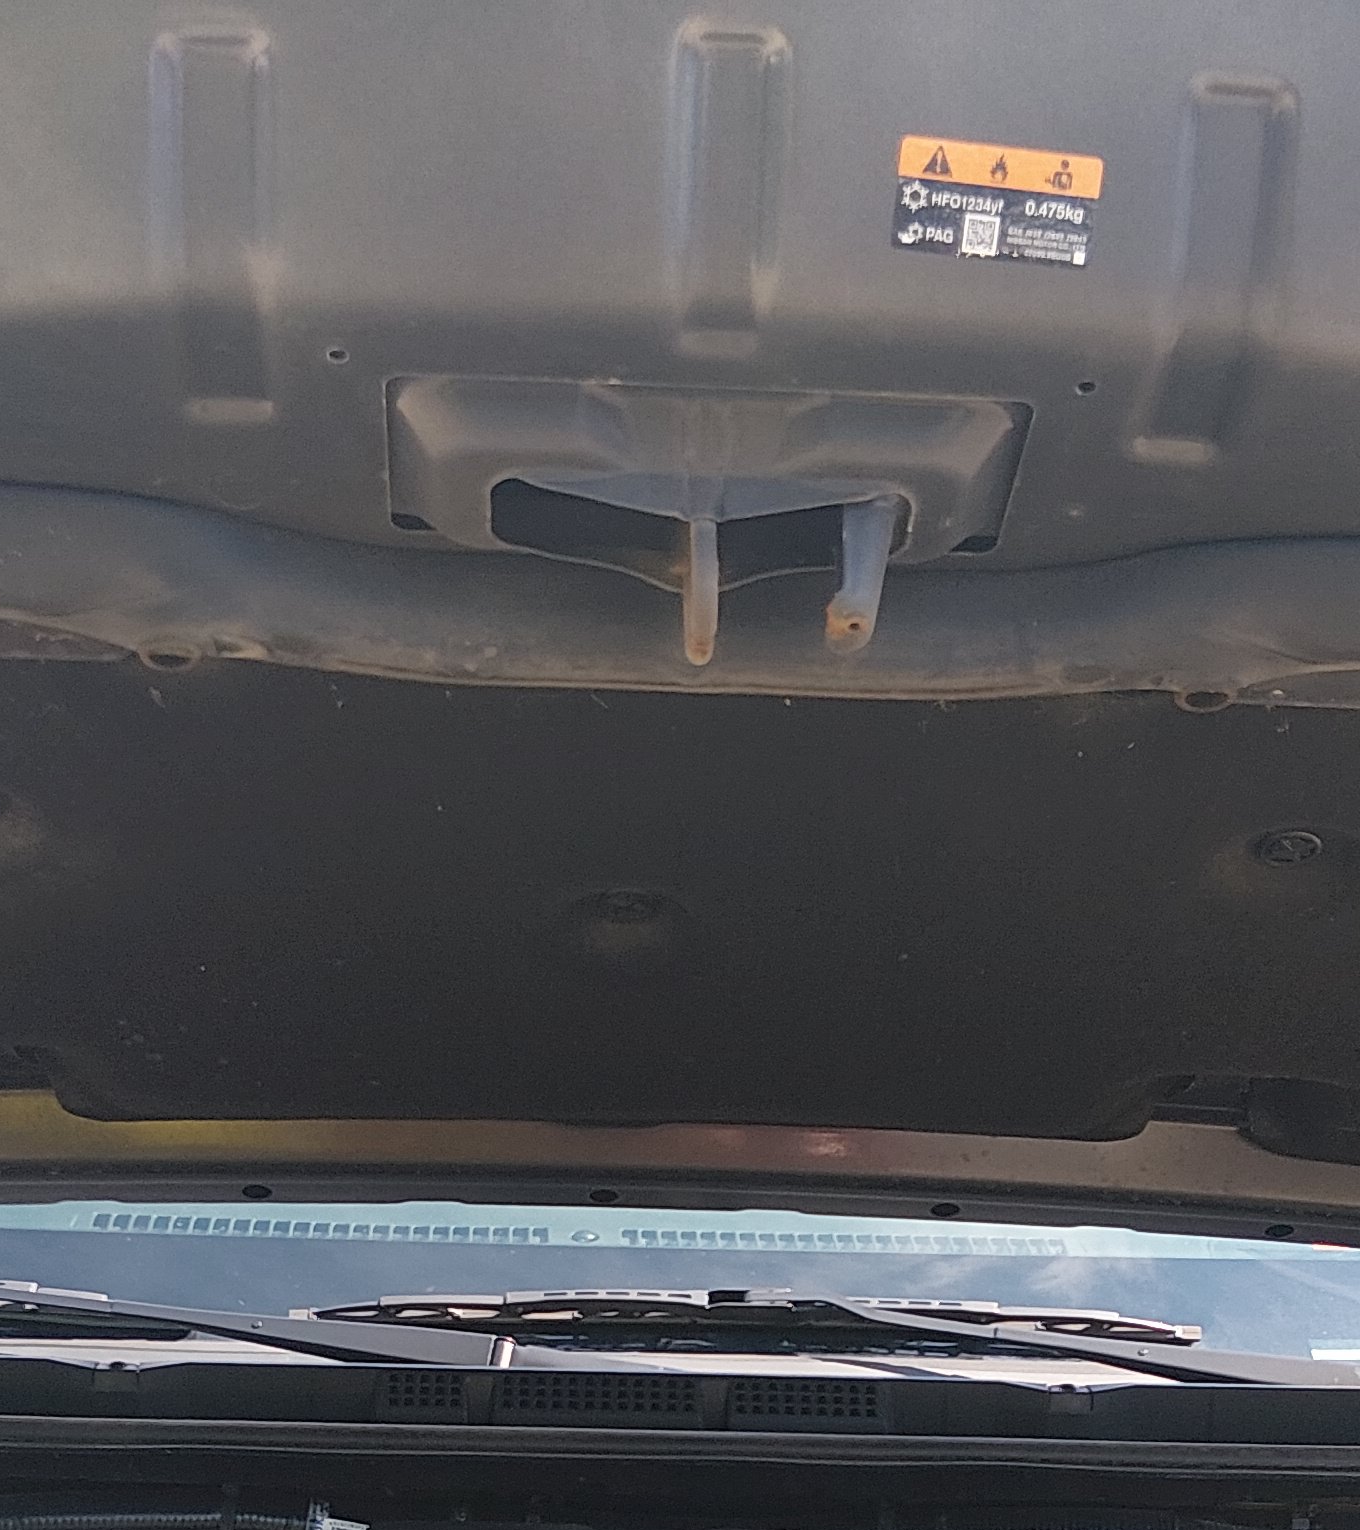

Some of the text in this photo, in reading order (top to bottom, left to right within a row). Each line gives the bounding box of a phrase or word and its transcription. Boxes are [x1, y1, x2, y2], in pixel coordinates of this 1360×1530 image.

[931, 191, 1084, 224] HFO1234yf 0.475kg
[925, 227, 954, 244] PAG
